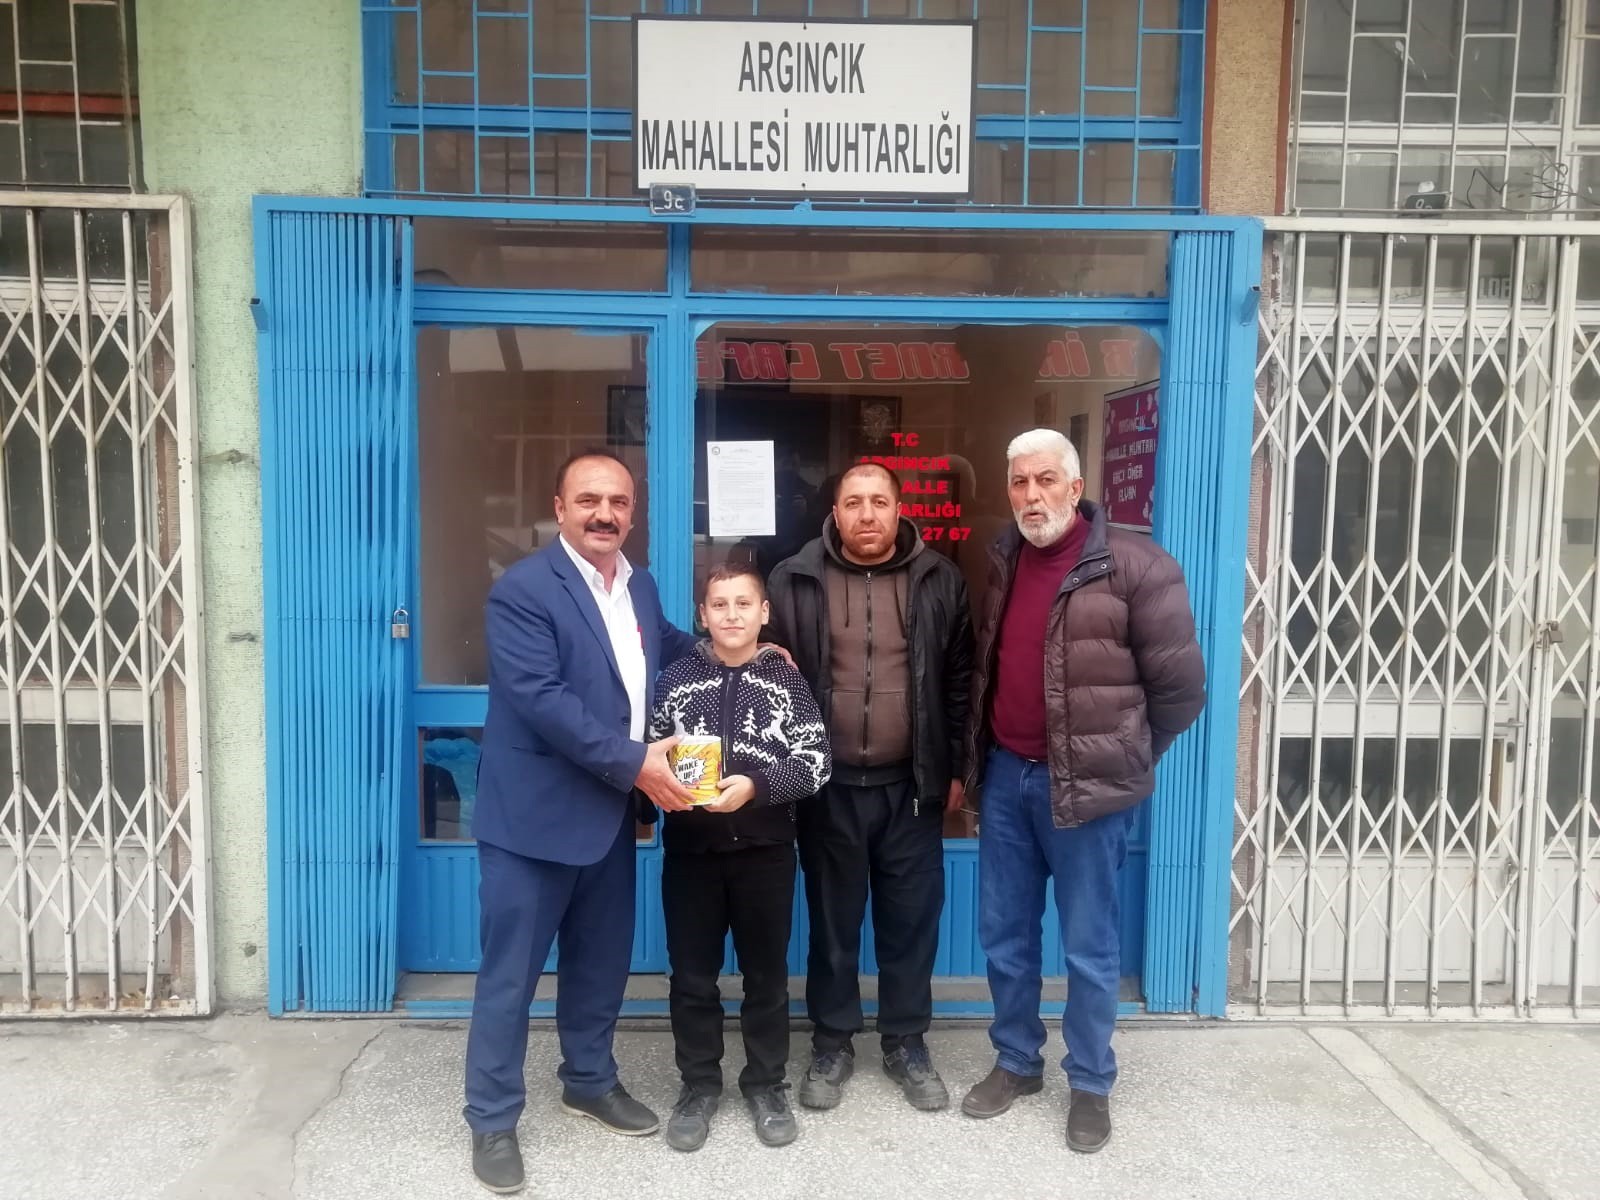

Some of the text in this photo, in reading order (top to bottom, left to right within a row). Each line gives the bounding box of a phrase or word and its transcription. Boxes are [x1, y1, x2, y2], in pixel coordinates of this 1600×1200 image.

[738, 41, 865, 94] ARGINCIK
[641, 108, 961, 175] MAHALLESİ MUHTARLIĞI
[891, 432, 920, 447] T.C
[901, 480, 949, 494] ALLE
[900, 501, 961, 518] ARLIĞI
[922, 527, 972, 541] 27 67
[677, 760, 699, 772] WAKE
